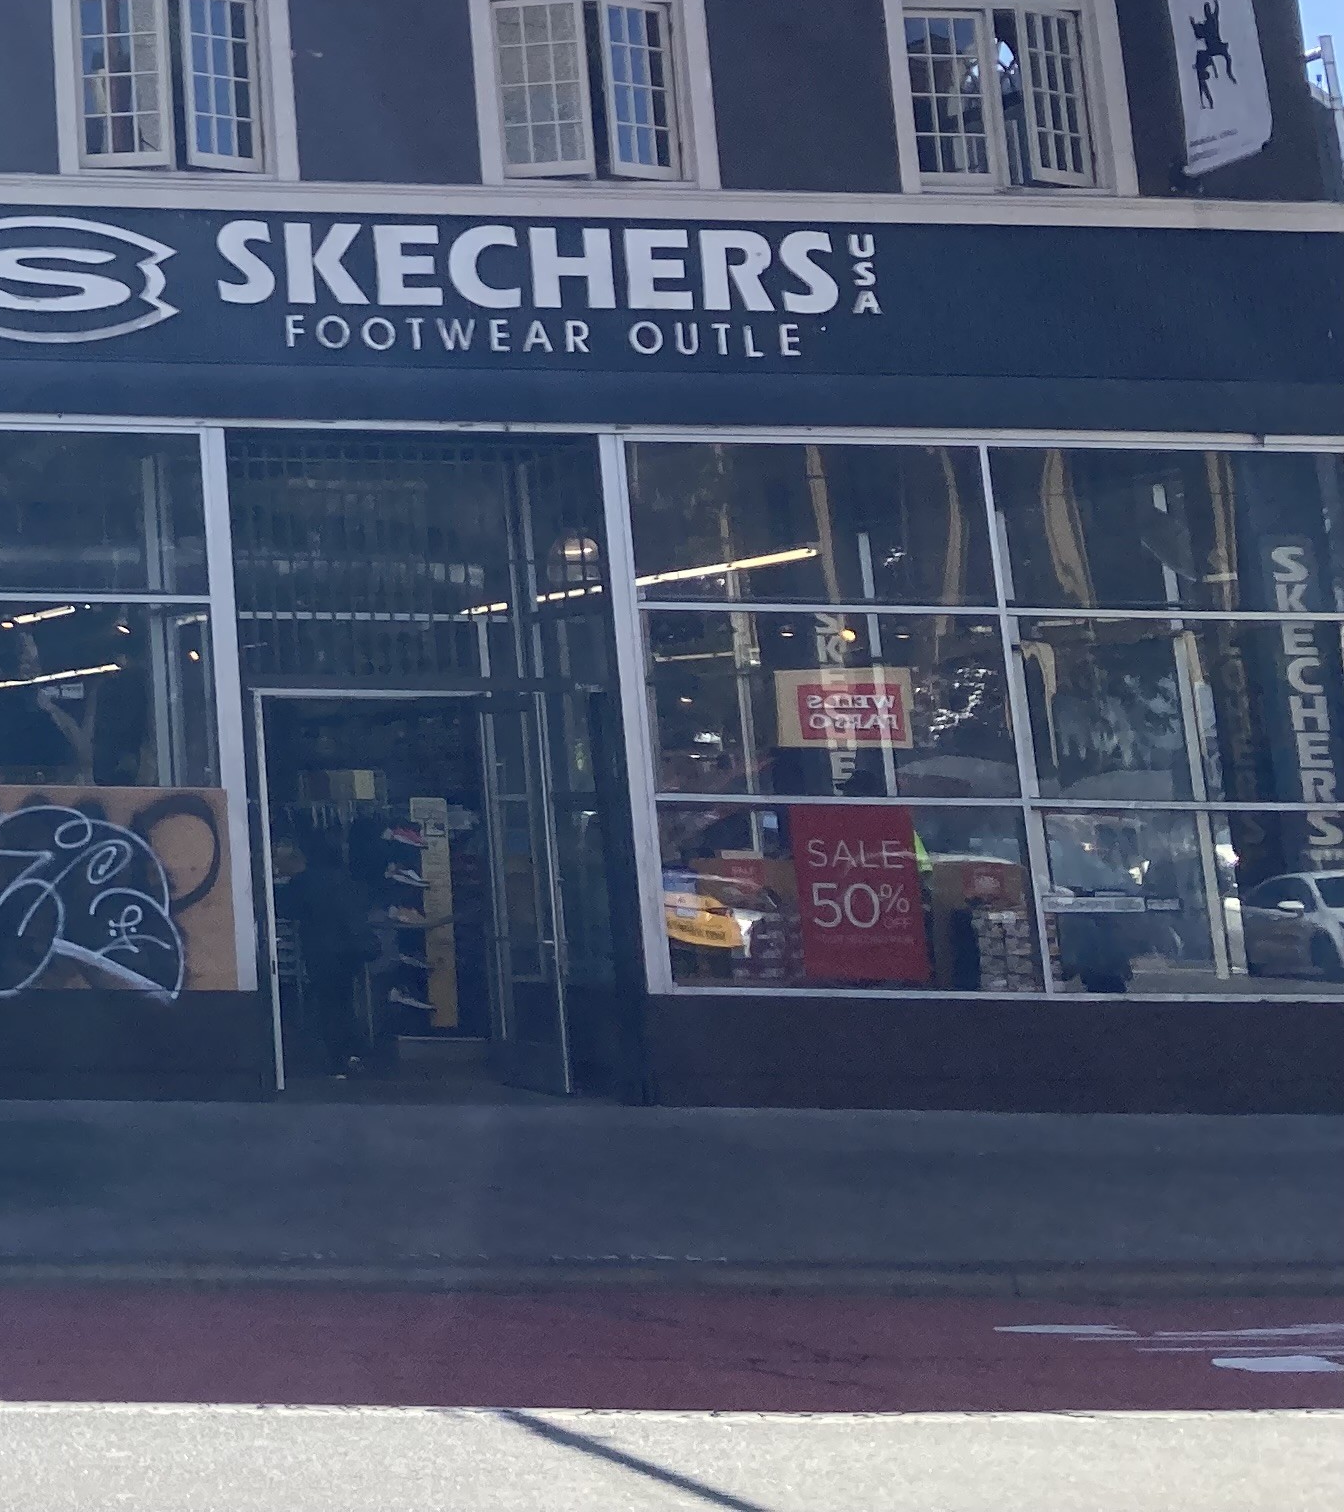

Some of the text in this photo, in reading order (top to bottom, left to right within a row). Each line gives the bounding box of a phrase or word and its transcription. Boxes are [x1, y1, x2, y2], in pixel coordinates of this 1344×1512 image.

[215, 220, 883, 315] SKECHERS USA
[286, 313, 591, 355] FOOTWEAR
[1270, 545, 1344, 846] SKECHERS
[807, 839, 905, 869] SALE
[812, 882, 911, 929] 50%
